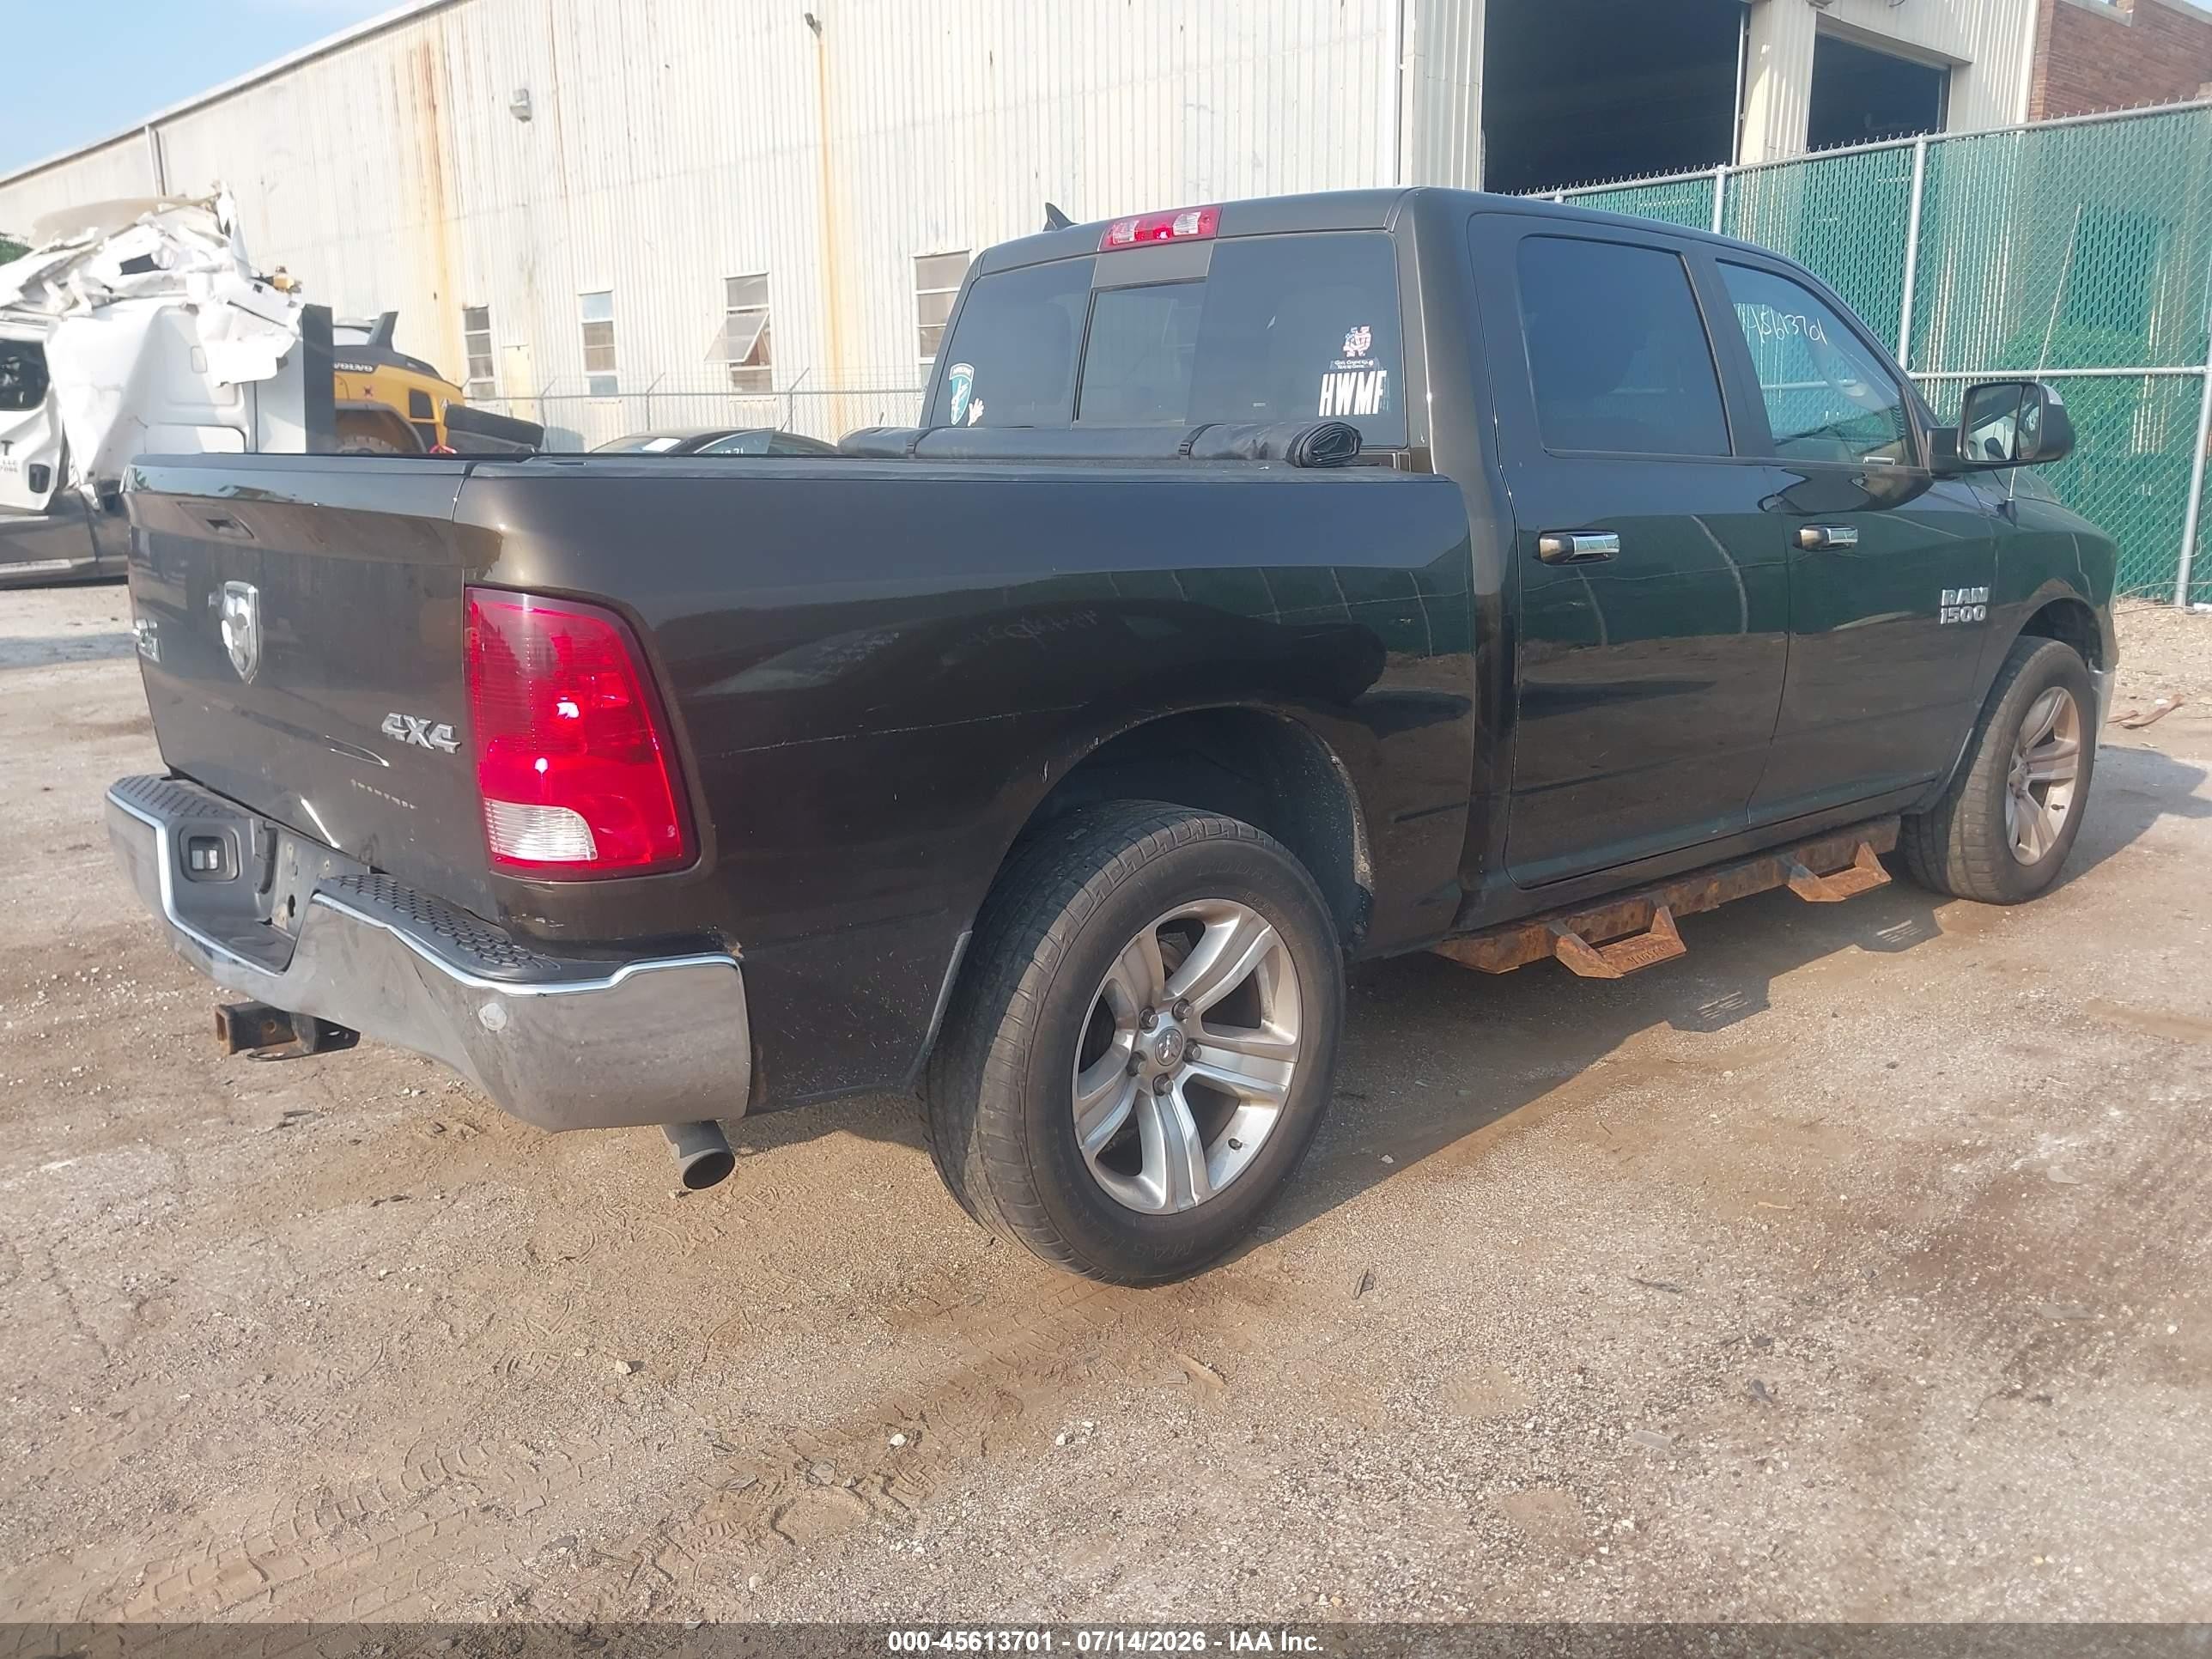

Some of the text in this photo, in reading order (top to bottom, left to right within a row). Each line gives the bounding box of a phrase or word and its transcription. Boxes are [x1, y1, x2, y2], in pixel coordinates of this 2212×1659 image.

[1319, 370, 1388, 416] HWMF
[1942, 586, 1989, 606] RAM
[1940, 605, 1986, 624] 1500
